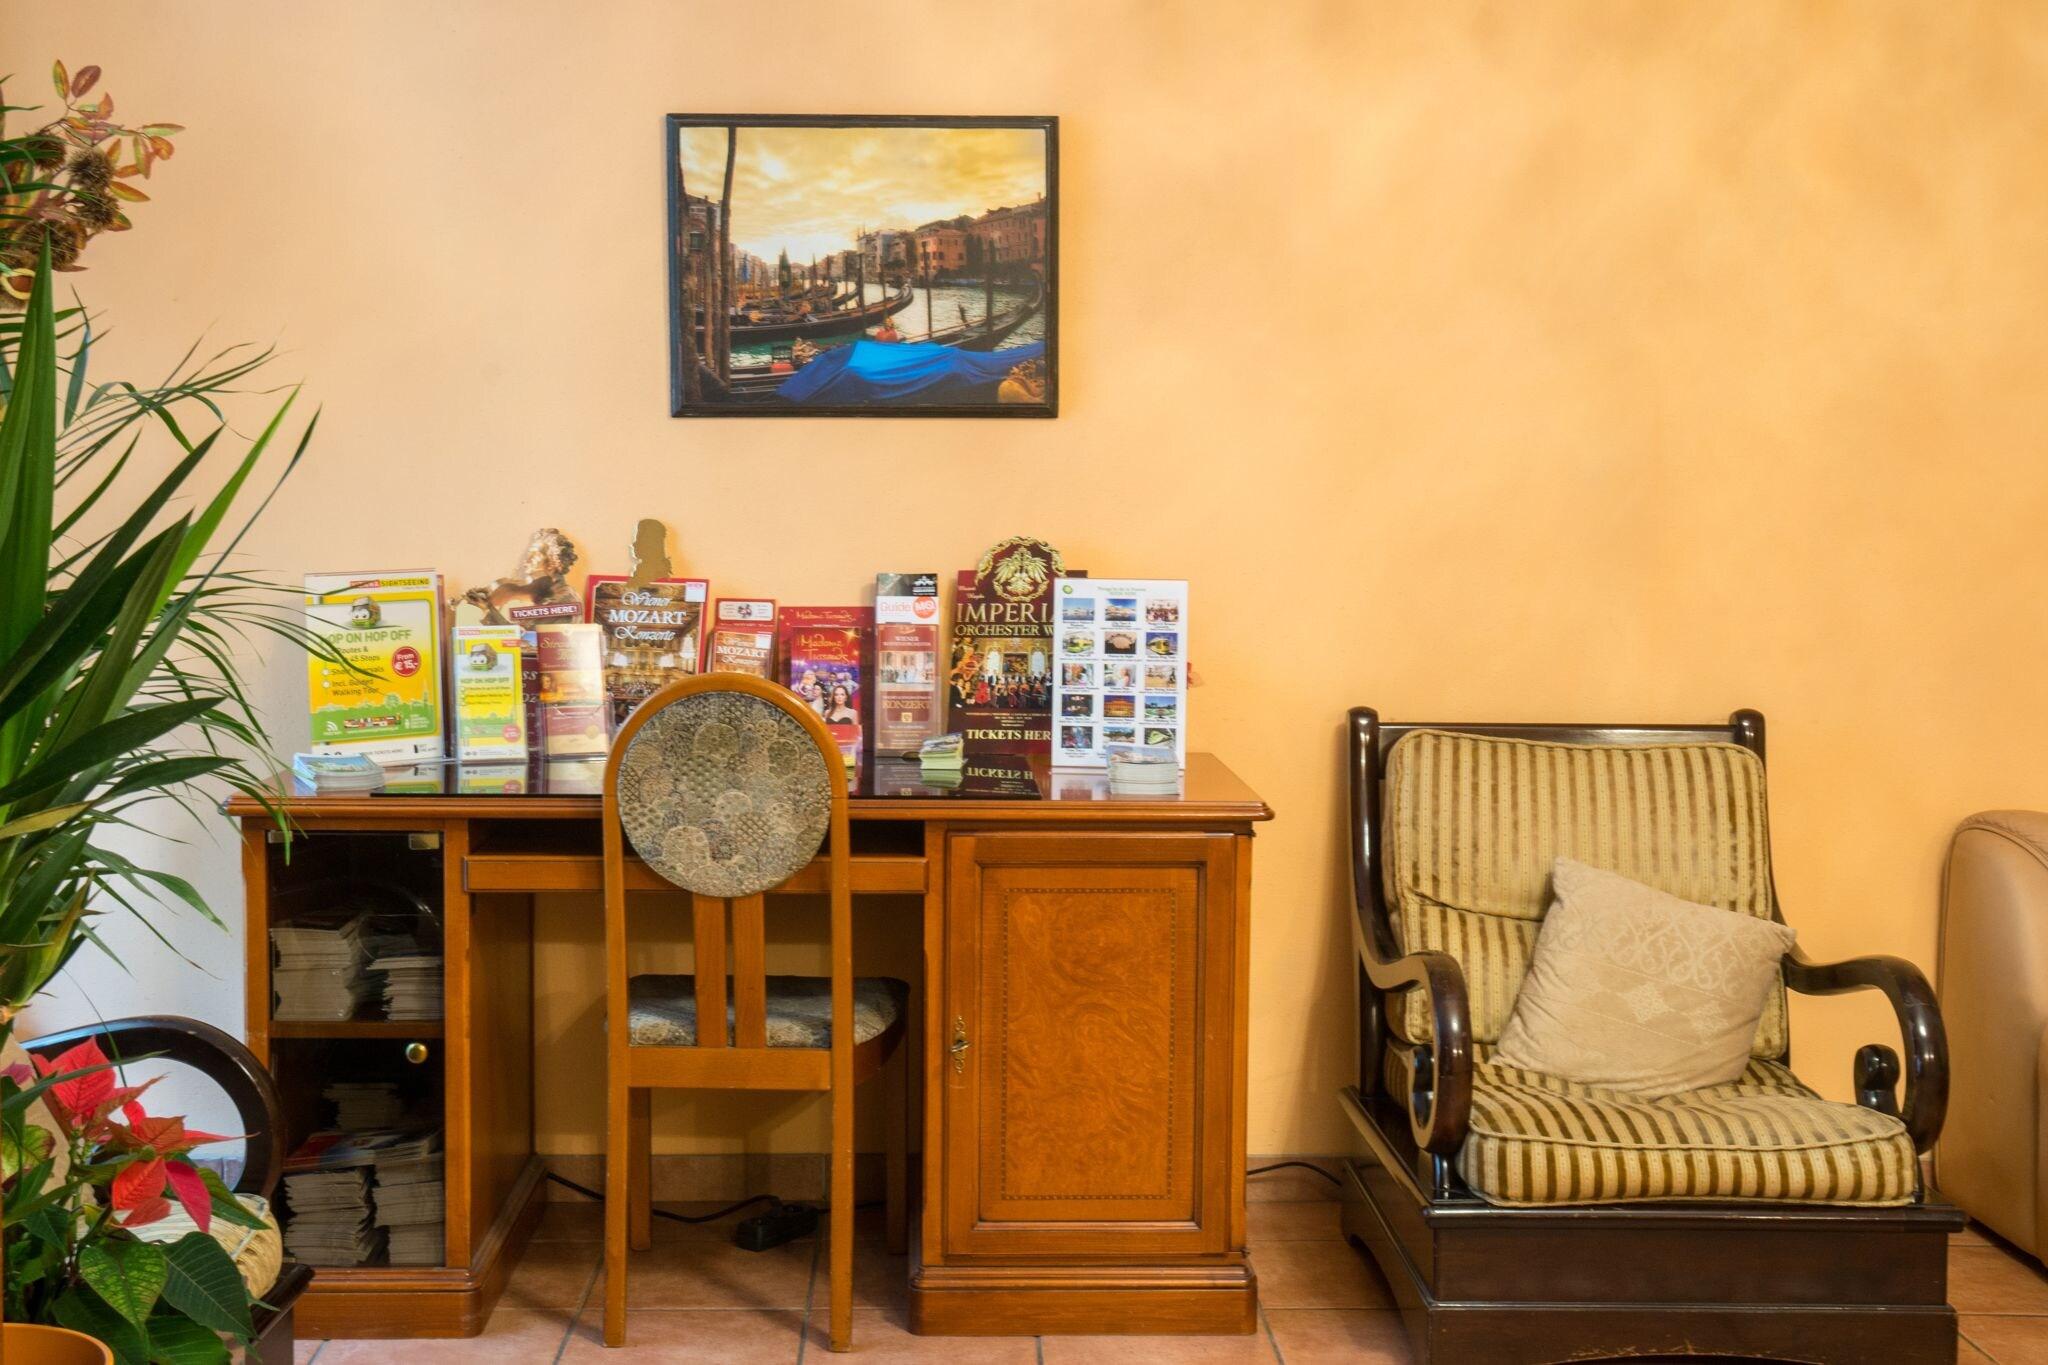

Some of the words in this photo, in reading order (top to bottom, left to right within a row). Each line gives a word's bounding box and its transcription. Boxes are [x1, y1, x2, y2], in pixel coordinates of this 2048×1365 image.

[381, 578, 430, 587] SIGHTSEEING
[621, 591, 673, 607] Wiener
[512, 607, 549, 618] TICKETS
[550, 605, 577, 615] HERE!
[608, 609, 687, 625] MOZART
[956, 603, 1054, 623] IMPERI
[346, 633, 362, 643] ON
[365, 631, 388, 641] HOP
[391, 629, 412, 640] OFF
[614, 625, 676, 641] Konzerte
[955, 624, 1041, 636] ORCHESTER
[716, 645, 768, 658] MOZART
[966, 729, 1022, 740] TICKETS
[1024, 730, 1053, 741] HER
